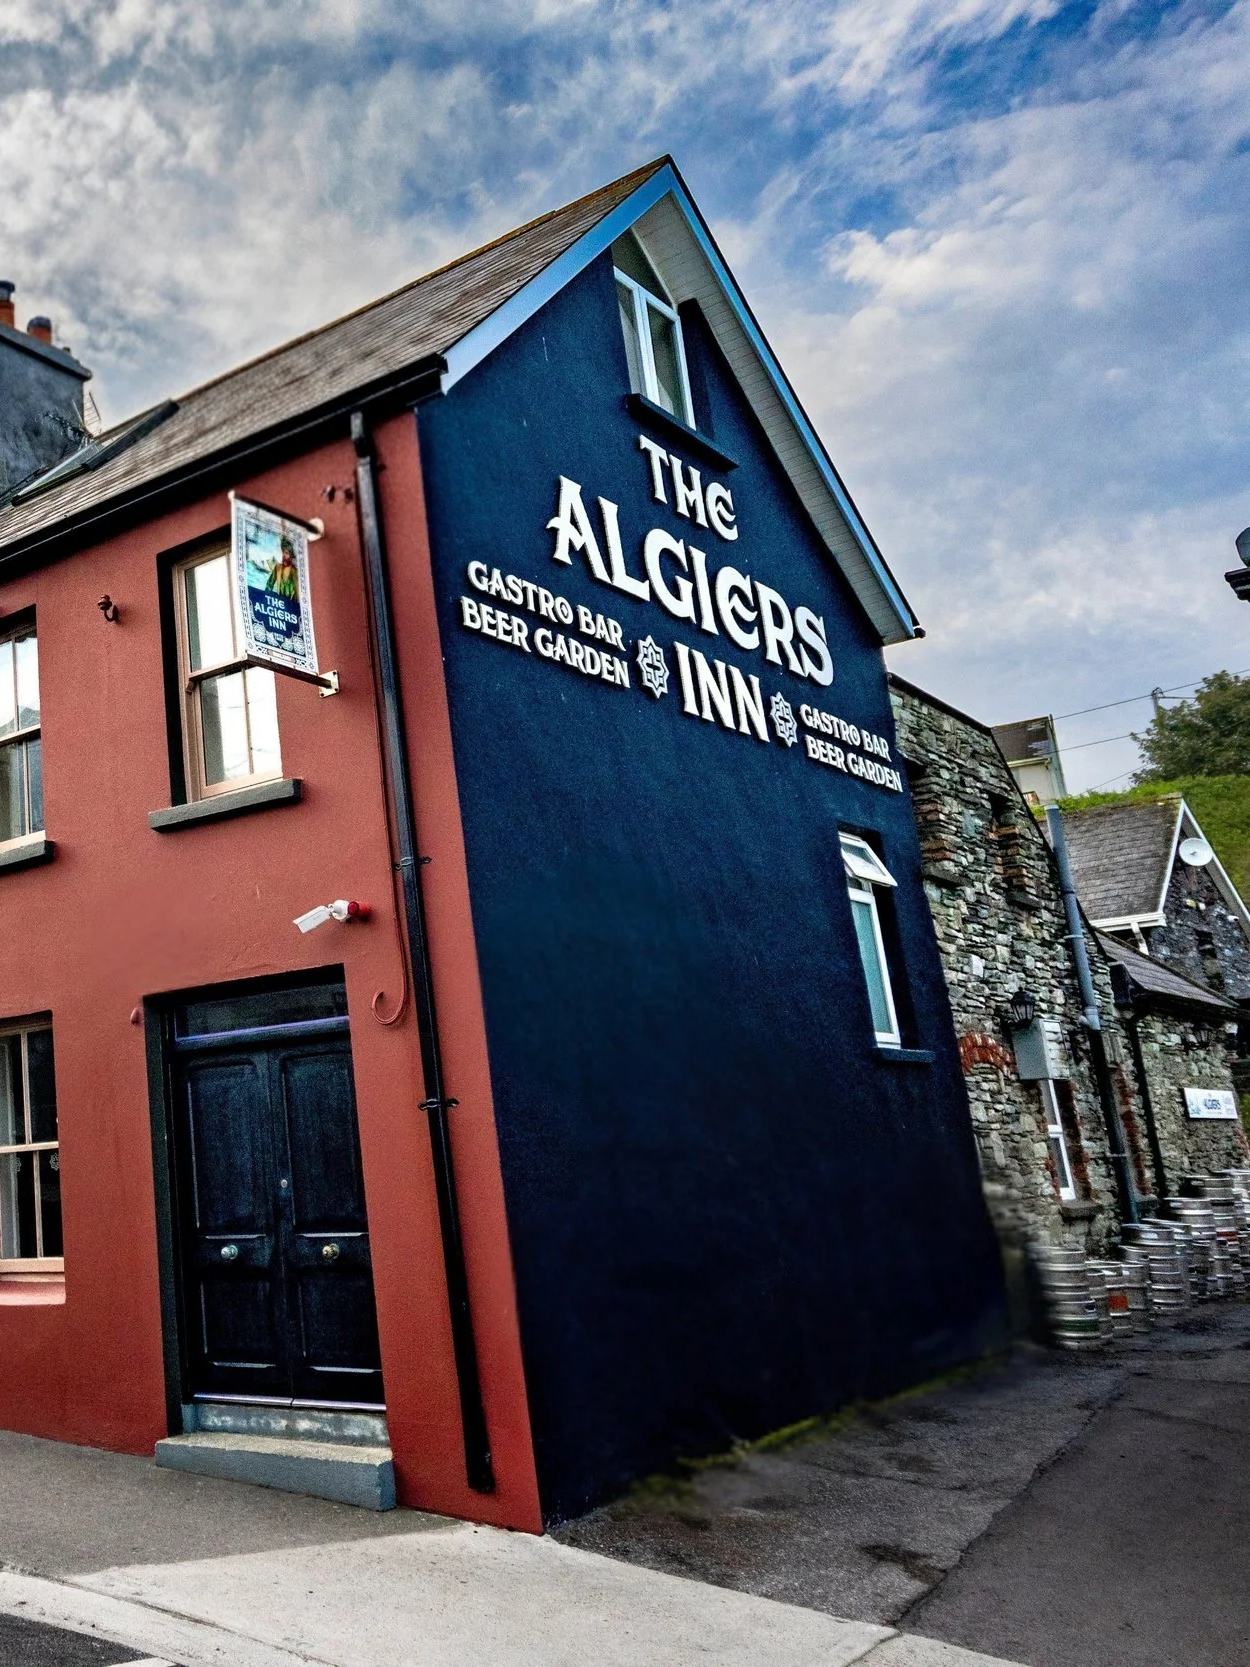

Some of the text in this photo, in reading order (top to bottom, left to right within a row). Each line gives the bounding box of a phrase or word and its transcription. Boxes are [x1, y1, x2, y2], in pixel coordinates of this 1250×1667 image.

[640, 434, 738, 541] THE
[254, 602, 297, 624] ALGIERS
[265, 595, 285, 609] THE
[467, 560, 626, 651] GASTRO BAR
[546, 475, 834, 686] ALGIERS
[269, 617, 286, 631] INN
[461, 596, 630, 688] BEER GARDEN
[674, 641, 770, 742] INN
[799, 703, 892, 762] GASTRO BAR
[807, 735, 903, 793] BEER GARDEN
